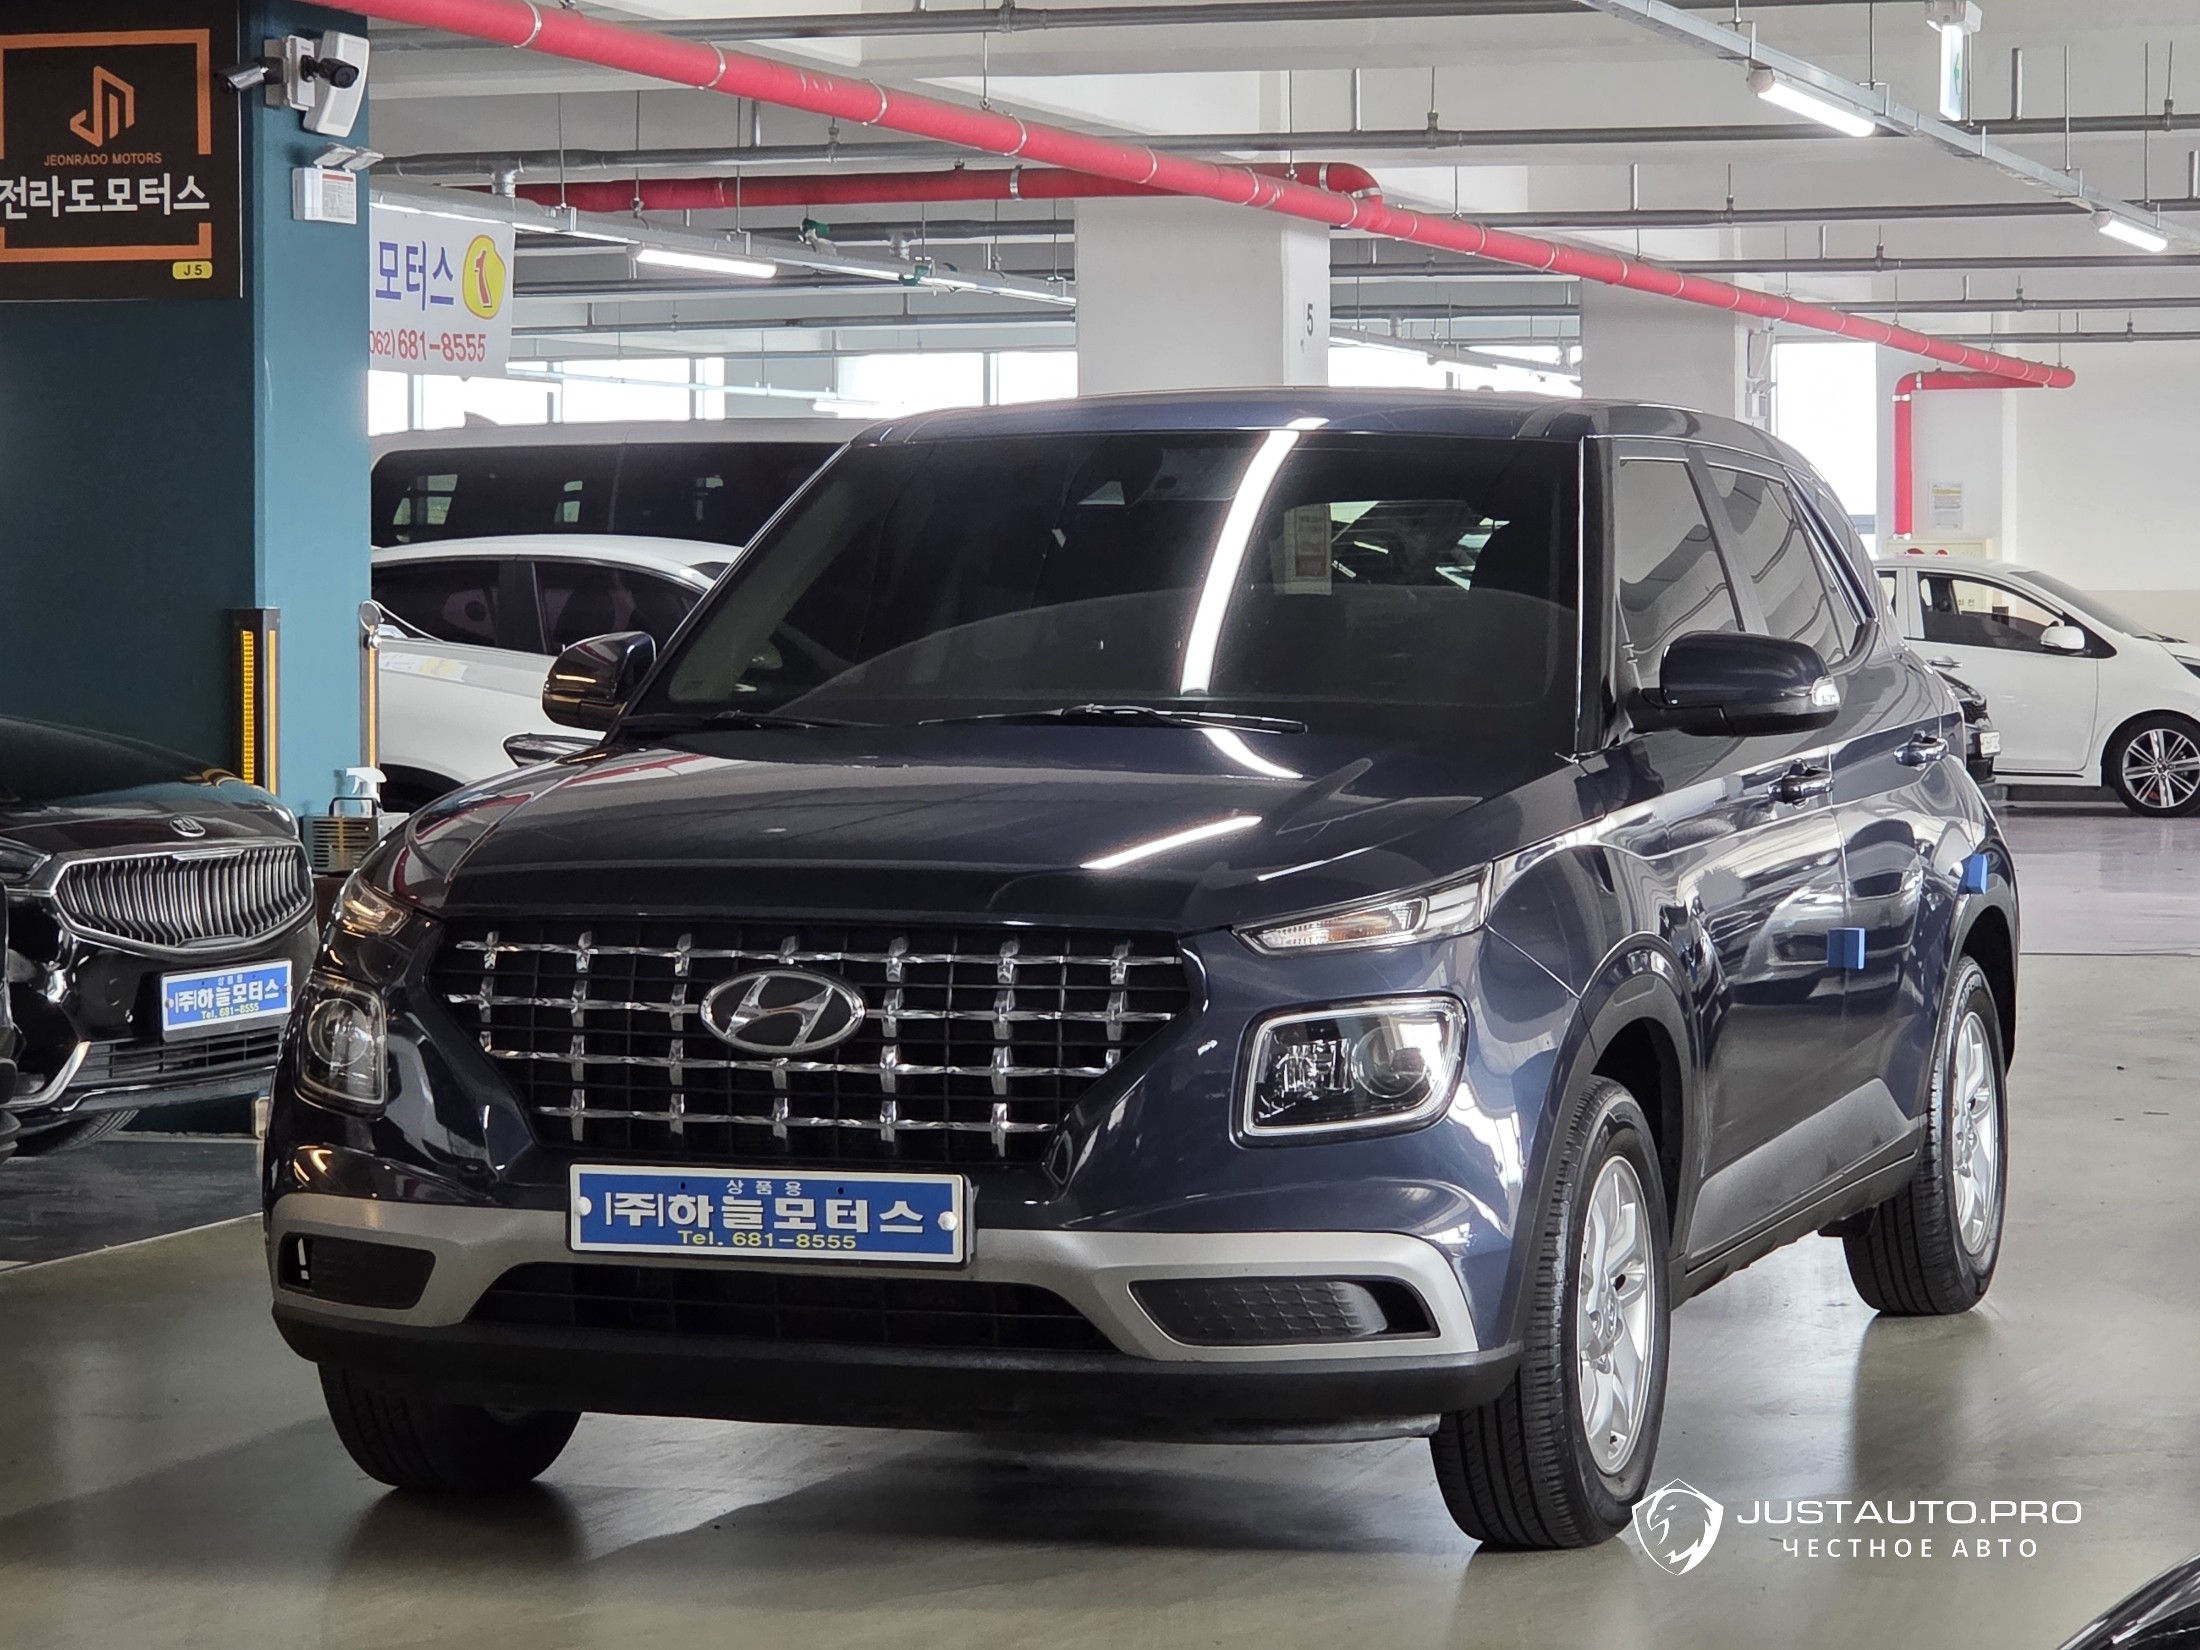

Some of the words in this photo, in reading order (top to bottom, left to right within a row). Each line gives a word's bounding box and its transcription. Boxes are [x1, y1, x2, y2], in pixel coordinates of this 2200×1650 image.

[44, 154, 109, 167] JEONRADO
[112, 152, 162, 165] MOTORS
[0, 172, 210, 219] 전라도모터스
[375, 240, 455, 311] 모터스
[1307, 303, 1314, 337] 5
[678, 1229, 724, 1246] Tel.
[732, 1231, 857, 1249] 681-8555
